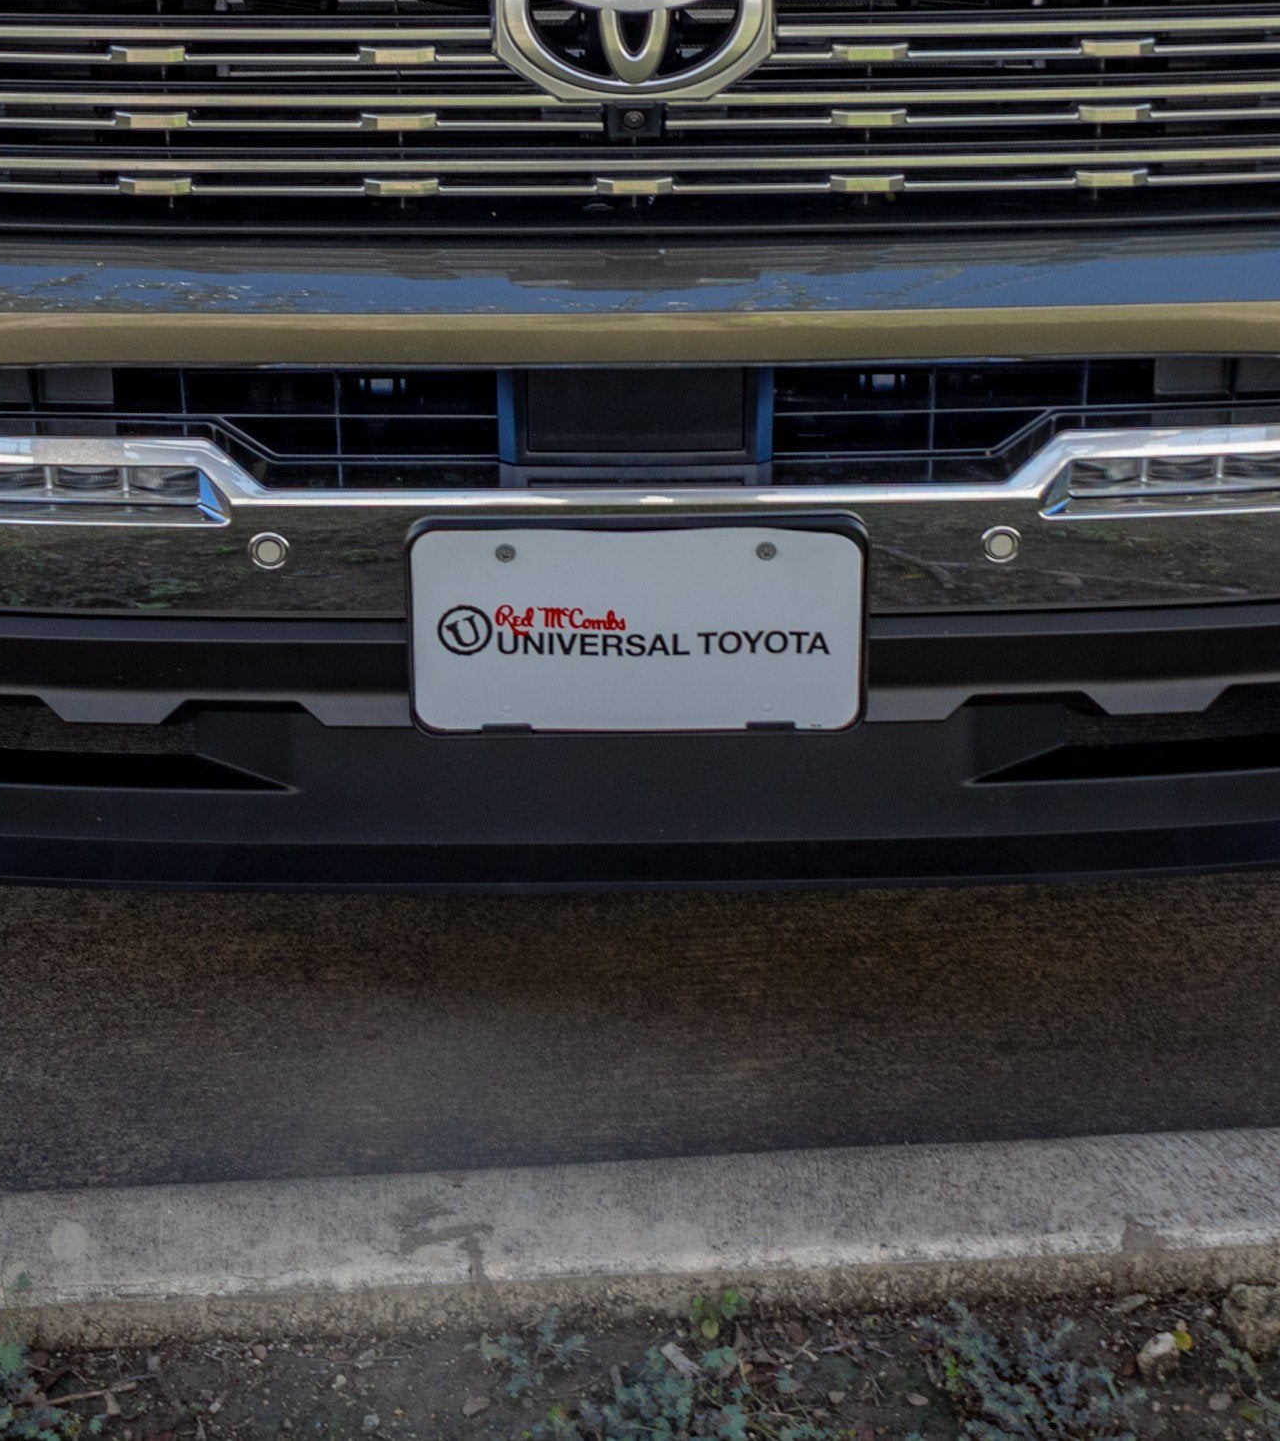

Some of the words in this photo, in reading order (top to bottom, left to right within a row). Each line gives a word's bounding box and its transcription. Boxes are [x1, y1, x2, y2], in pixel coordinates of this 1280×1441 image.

[495, 604, 534, 637] Red
[537, 606, 626, 631] McCombs
[497, 631, 690, 656] UNIVERSAL
[697, 631, 831, 655] TOYOTA
